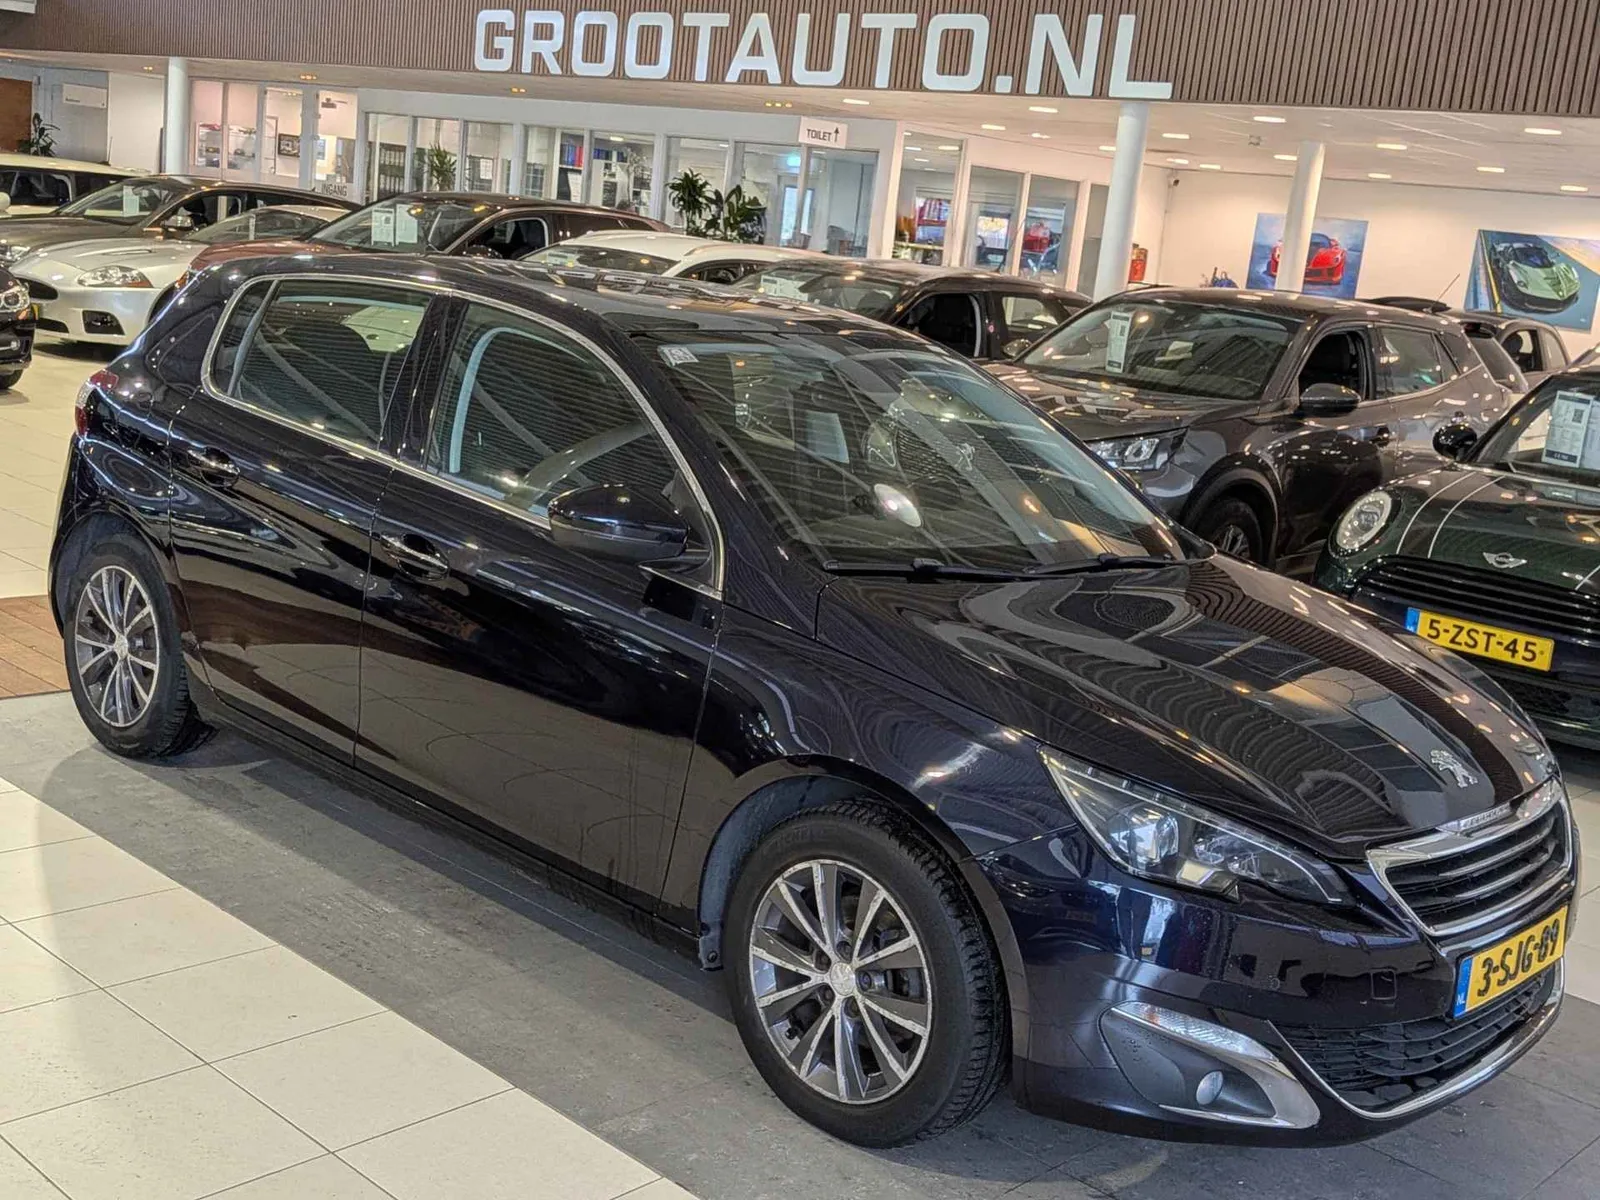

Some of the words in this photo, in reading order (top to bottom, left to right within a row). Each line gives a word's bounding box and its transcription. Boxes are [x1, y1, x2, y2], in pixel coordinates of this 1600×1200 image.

[474, 9, 1173, 99] GROOTAUTO.NL
[807, 129, 832, 141] TOILET
[322, 183, 348, 197] INGANG
[1426, 618, 1537, 663] 5-ZST-45
[1477, 918, 1560, 997] 3-SJG-89
[1456, 993, 1466, 1006] NL
